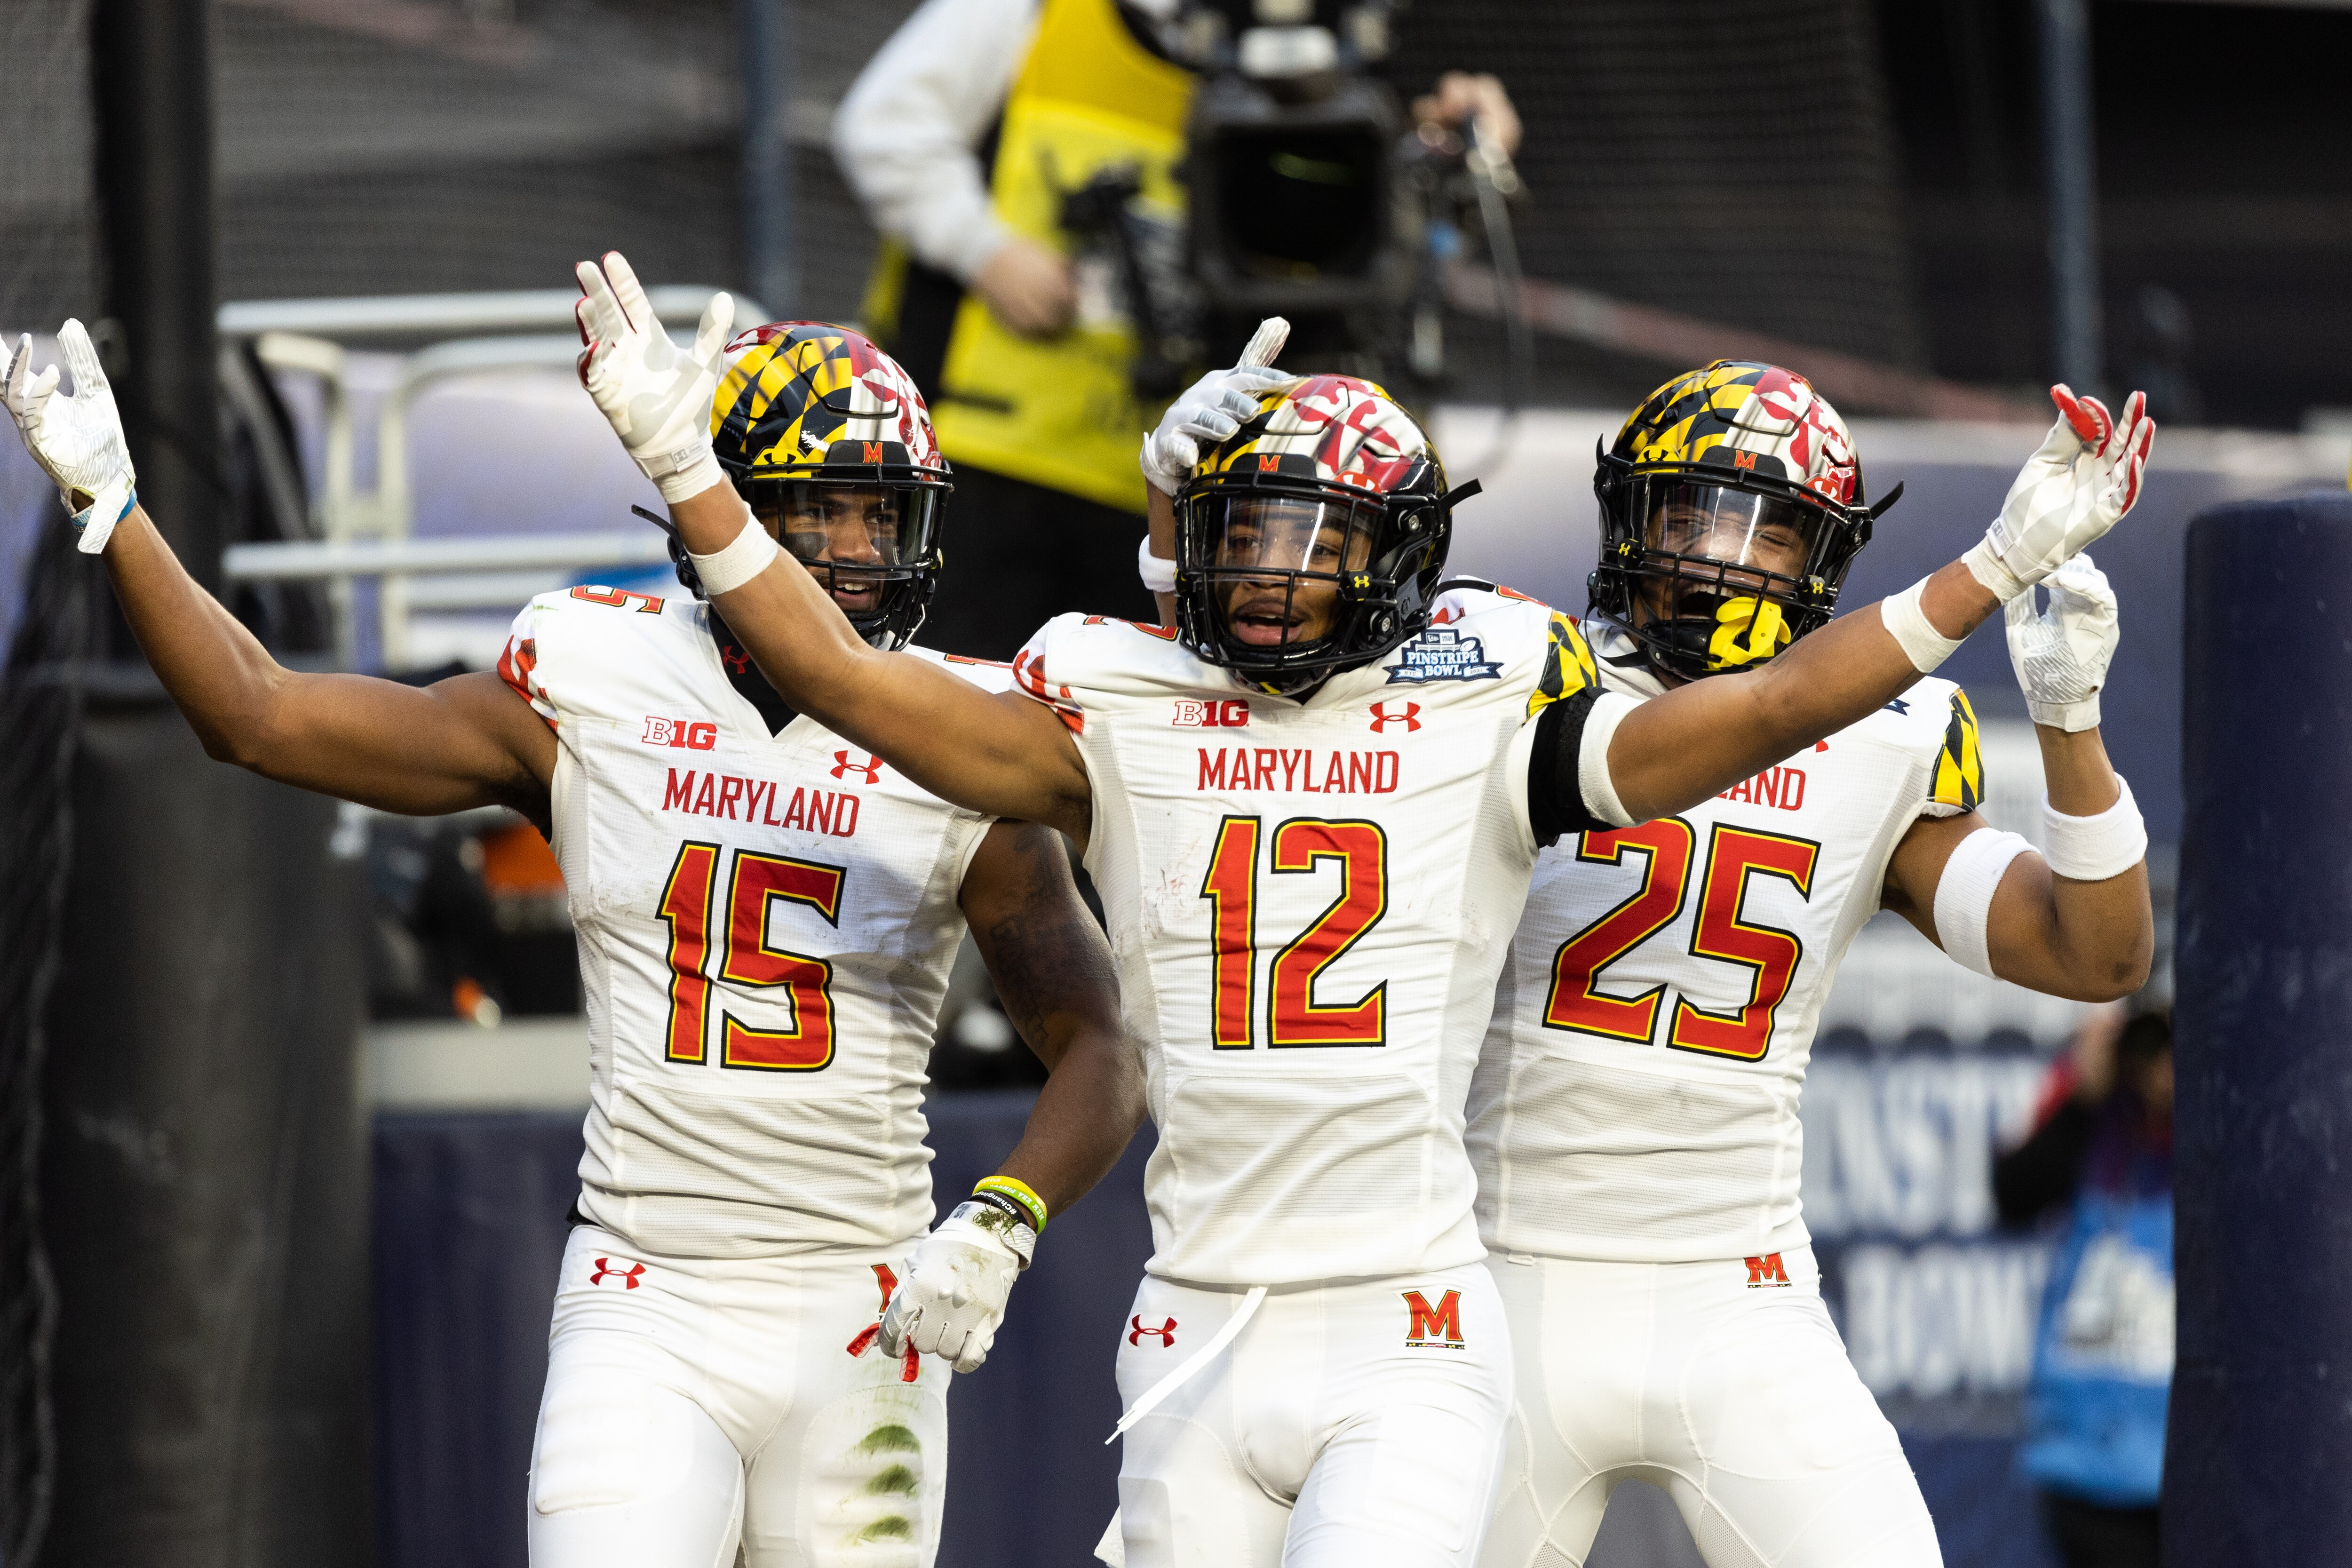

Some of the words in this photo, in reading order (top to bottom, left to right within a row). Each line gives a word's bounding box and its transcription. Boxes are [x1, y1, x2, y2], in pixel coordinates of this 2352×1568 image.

[863, 441, 883, 464] M
[1259, 454, 1281, 472] M
[1734, 450, 1758, 470] M
[1406, 651, 1478, 664] PINSTRIPE
[1425, 664, 1462, 676] BOWL
[1198, 748, 1399, 794] MARYLAND
[662, 767, 859, 837] MARYLAND
[1200, 815, 1388, 1050] 12
[1542, 816, 1822, 1062] 25
[655, 840, 847, 1072] 15
[1017, 1193, 1033, 1204] ERA
[1032, 1203, 1045, 1221] NEW
[1743, 1252, 1790, 1282] M
[1401, 1289, 1464, 1342] M
